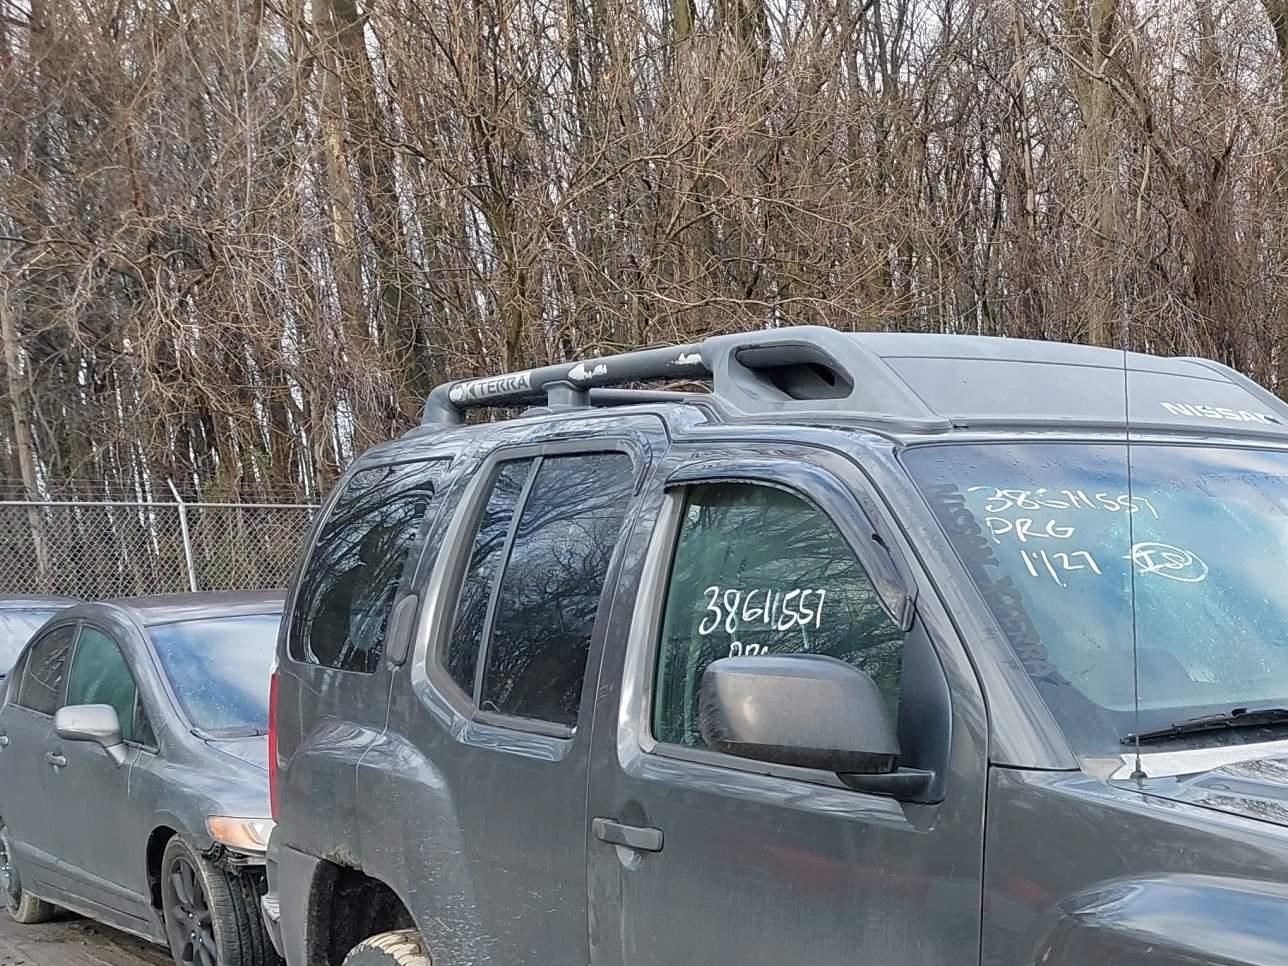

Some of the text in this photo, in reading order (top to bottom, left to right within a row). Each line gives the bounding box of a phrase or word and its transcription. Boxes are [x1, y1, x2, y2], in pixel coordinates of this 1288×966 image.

[459, 375, 530, 400] XTERRA
[1160, 401, 1279, 425] NISSAN
[984, 517, 1075, 543] PRG
[699, 586, 826, 635] 38611557
